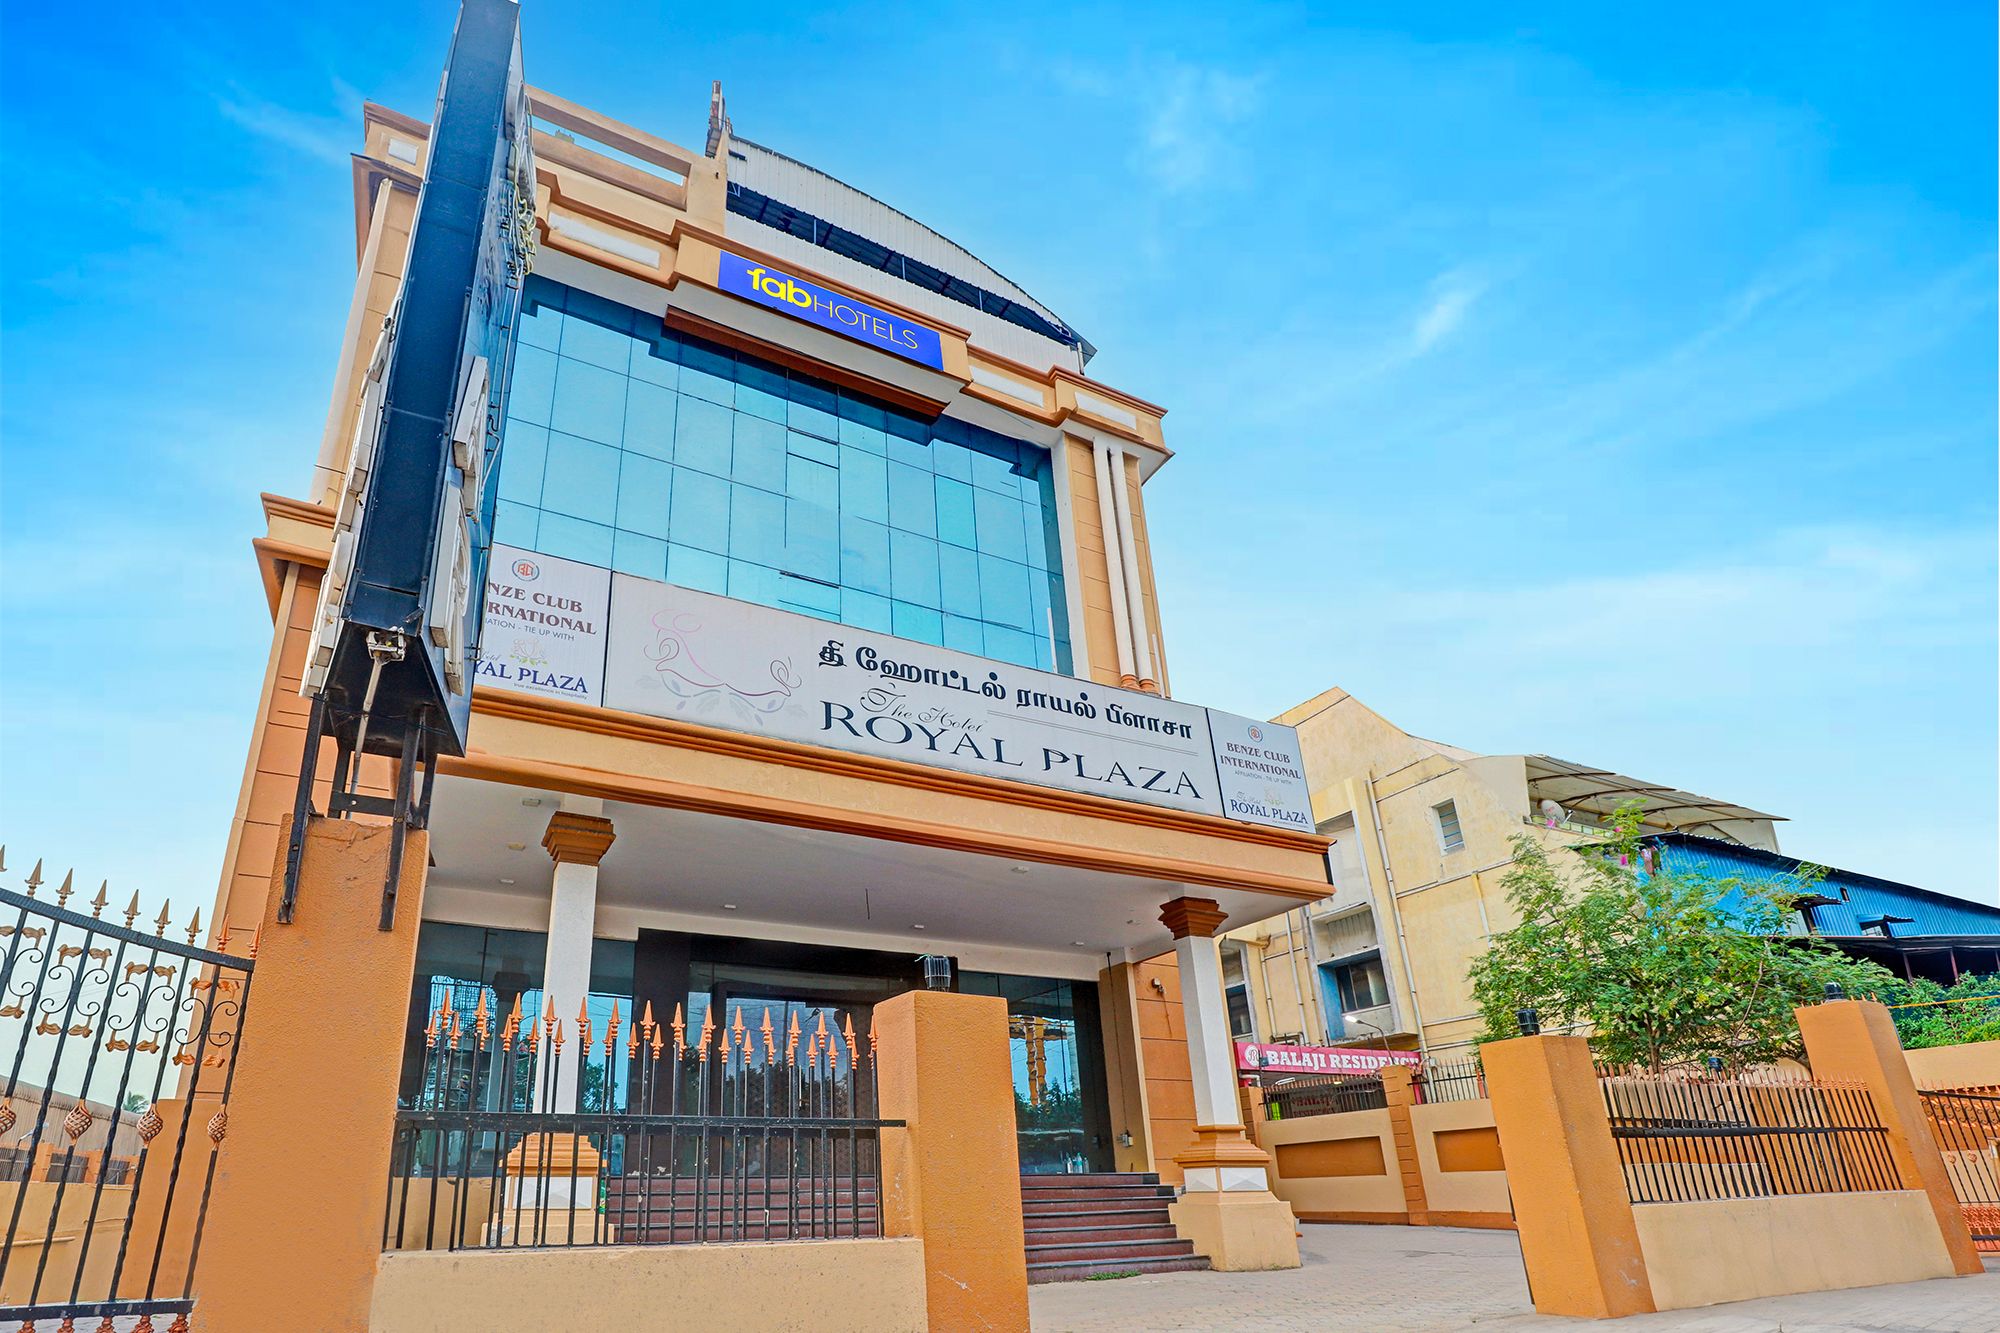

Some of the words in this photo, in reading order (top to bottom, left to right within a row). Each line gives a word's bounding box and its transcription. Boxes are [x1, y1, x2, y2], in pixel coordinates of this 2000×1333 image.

[488, 582, 526, 601] NZE
[532, 592, 583, 613] CLUB
[486, 618, 516, 629] IATION
[525, 625, 536, 634] TIE
[539, 628, 550, 636] UP
[552, 631, 575, 641] WITH
[487, 601, 597, 635] RNATIONAL
[475, 660, 512, 680] YAL
[517, 667, 588, 694] PLAZA
[818, 639, 847, 667] தி
[855, 646, 1006, 700] ஹோட்டல்
[1016, 688, 1097, 719] ராயல்
[1105, 703, 1192, 739] பிளாசா
[860, 682, 912, 719] The
[918, 706, 988, 733] Hotel
[819, 700, 1023, 766] ROYAL
[1042, 747, 1204, 800] PLAZA
[1226, 742, 1261, 757] BENZE
[1264, 750, 1290, 763] CLUB
[1220, 755, 1301, 779] INTERNATIONAL
[1230, 799, 1270, 818] ROYAL
[1272, 808, 1308, 824] PLAZA
[1266, 1050, 1326, 1071] BALAJI
